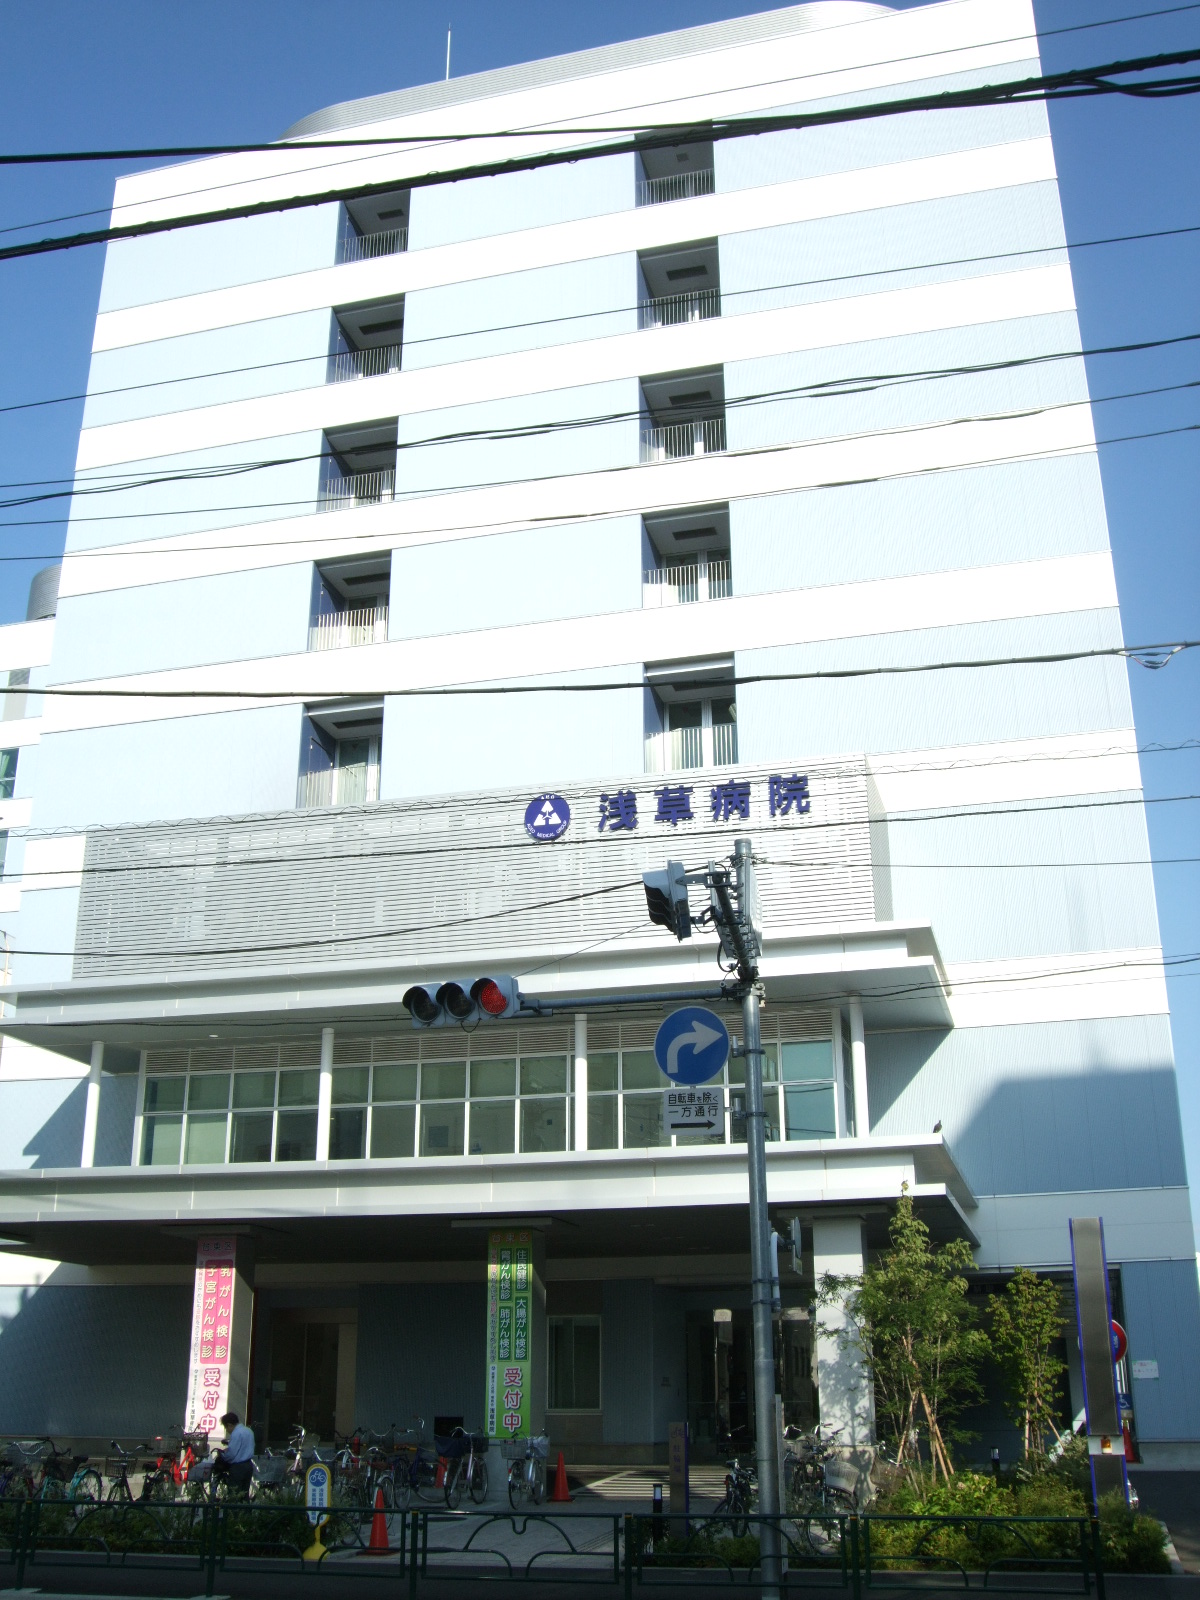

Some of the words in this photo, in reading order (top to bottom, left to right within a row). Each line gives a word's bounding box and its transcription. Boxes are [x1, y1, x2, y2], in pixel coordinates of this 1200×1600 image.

[599, 774, 810, 833] 浅草病院
[668, 1092, 718, 1104] 自転車を除く
[668, 1106, 719, 1118] 一方通行
[500, 1250, 511, 1300] 胃がん検診
[516, 1249, 528, 1290] 住民健診
[201, 1264, 217, 1358] 子宮がん検診
[215, 1264, 231, 1358] 乳がん検診
[499, 1308, 510, 1359] 肺がん検診
[515, 1298, 527, 1359] 大腸がん検診
[200, 1368, 221, 1434] 受付中
[503, 1367, 522, 1432] 受付中
